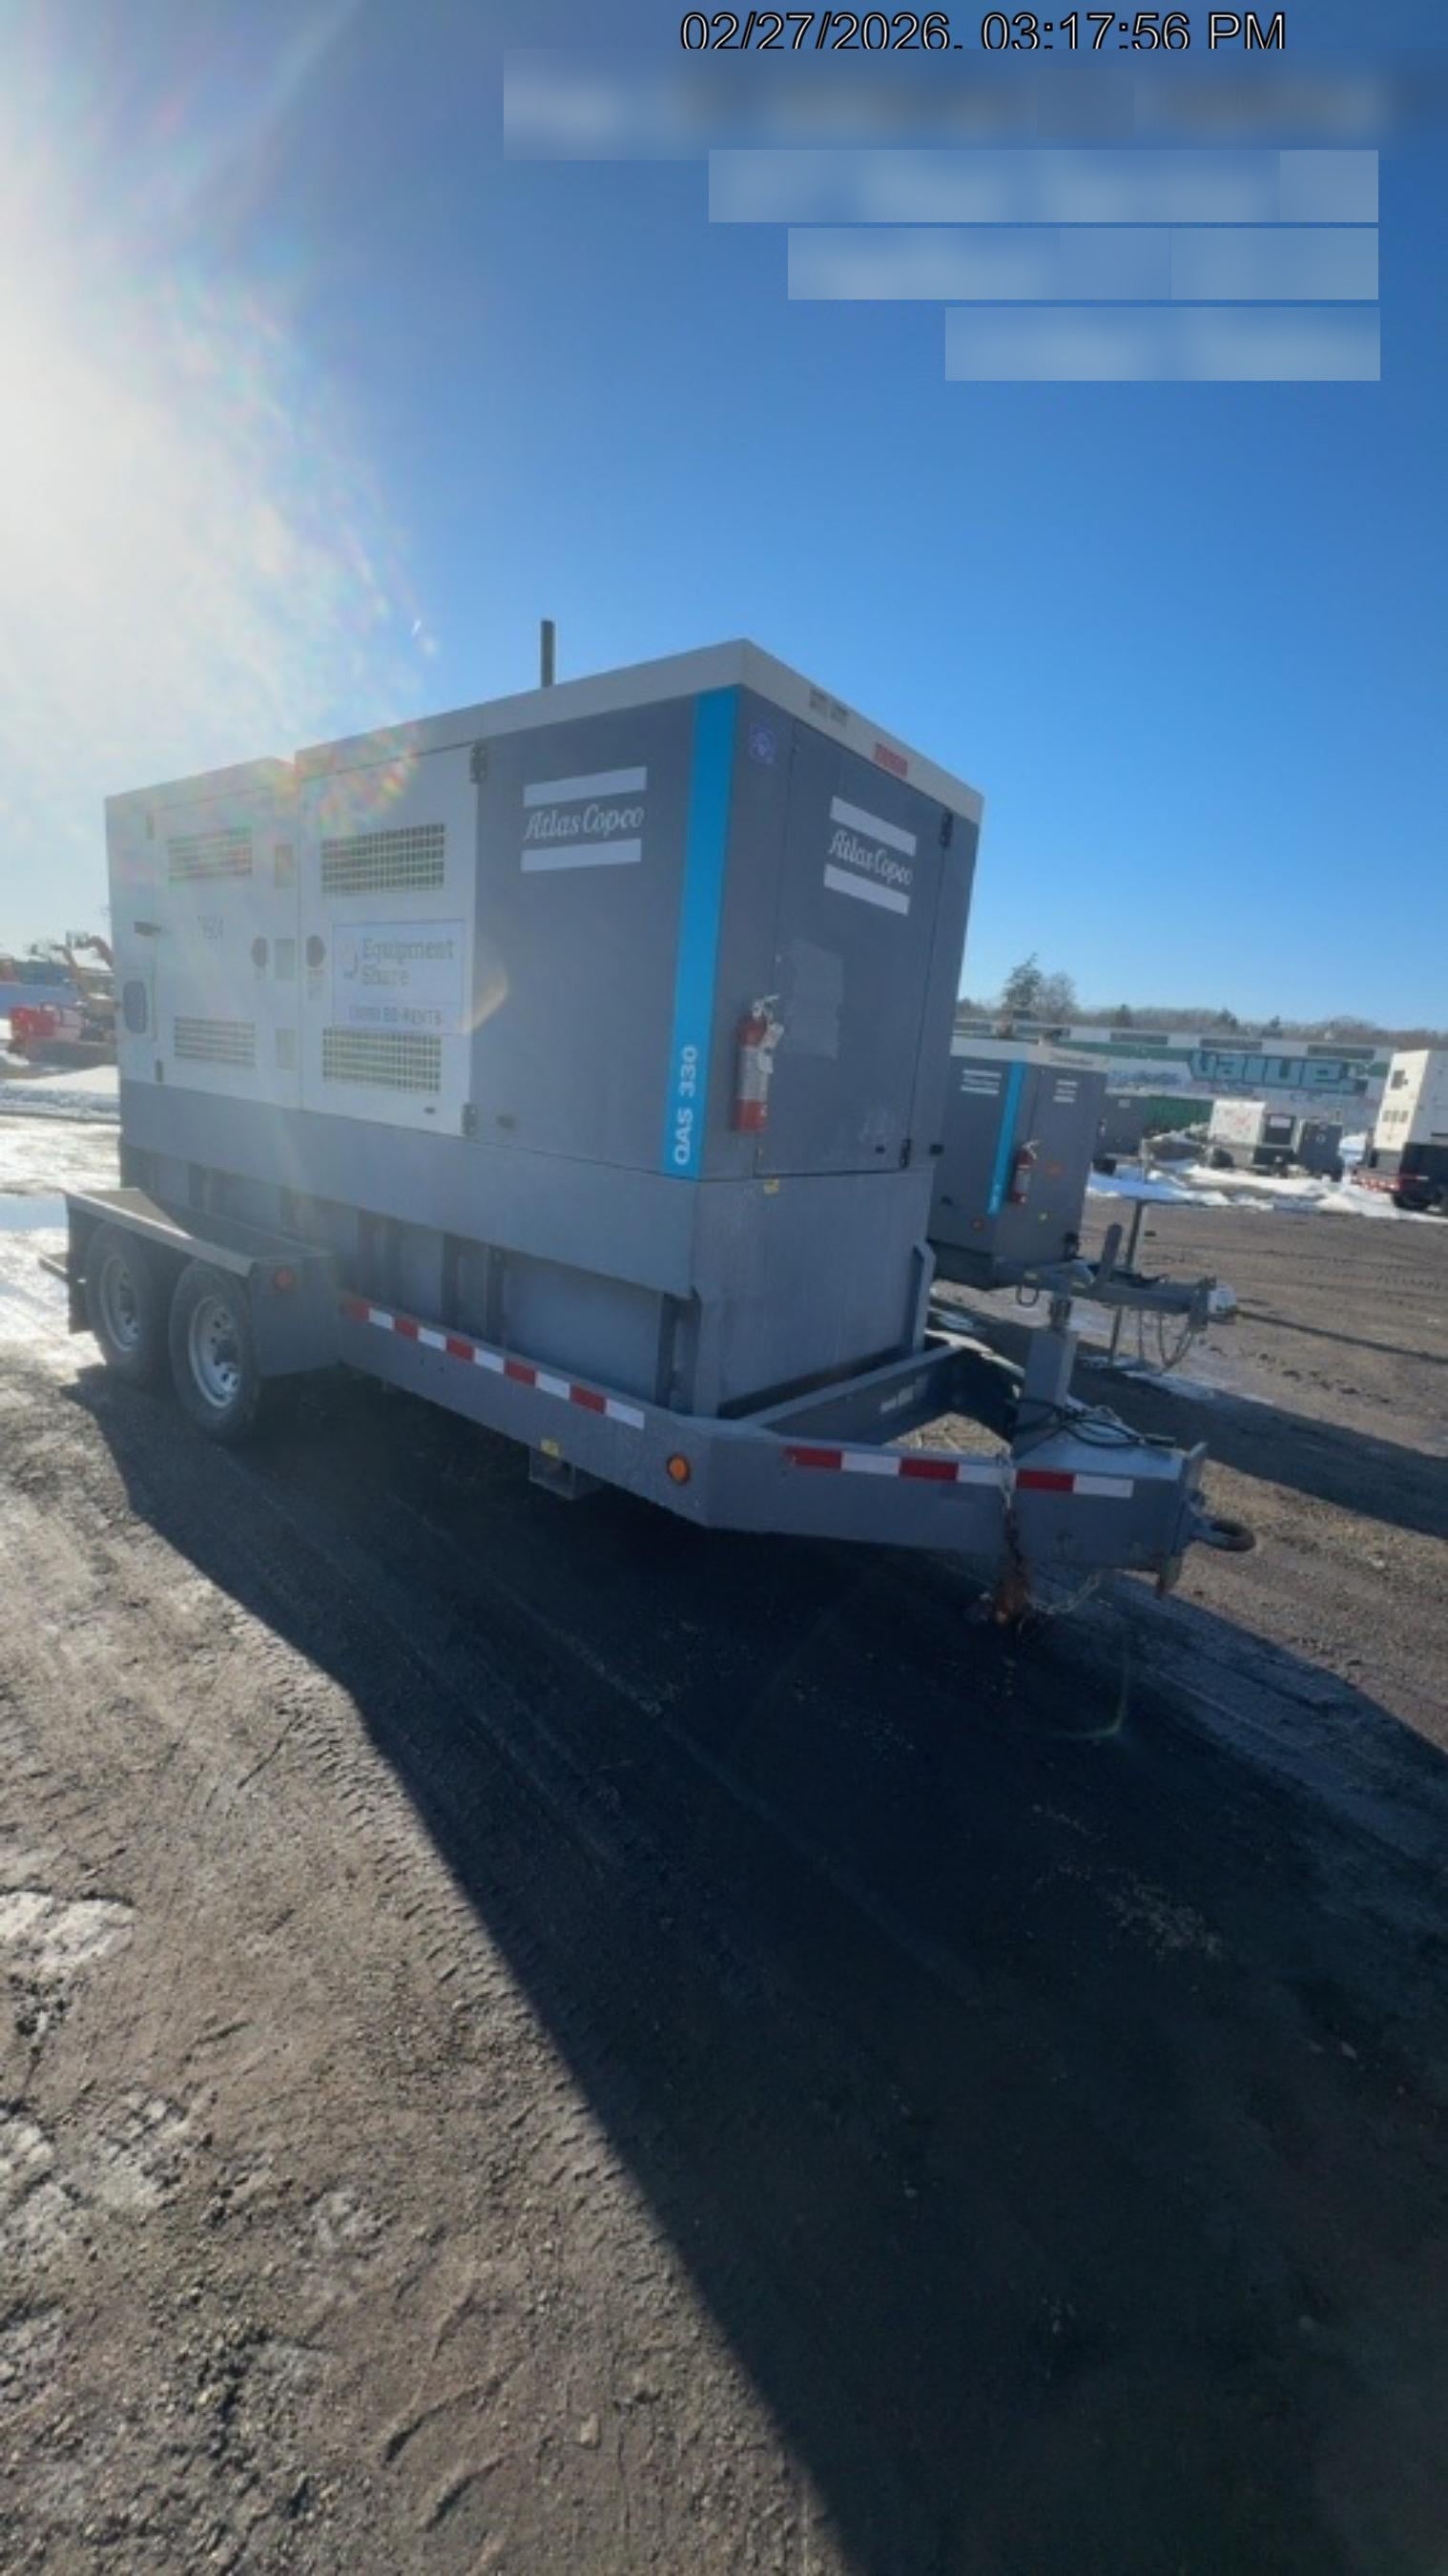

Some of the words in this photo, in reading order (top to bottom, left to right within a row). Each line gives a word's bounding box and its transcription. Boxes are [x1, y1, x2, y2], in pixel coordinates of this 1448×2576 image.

[526, 810, 581, 839] Atlas
[583, 803, 645, 839] Copco
[827, 829, 873, 870] Atlas
[875, 847, 913, 885] Copco
[362, 938, 454, 965] Equipment
[362, 964, 411, 986] Share
[677, 1045, 698, 1098] 330
[673, 1107, 693, 1165] QAS
